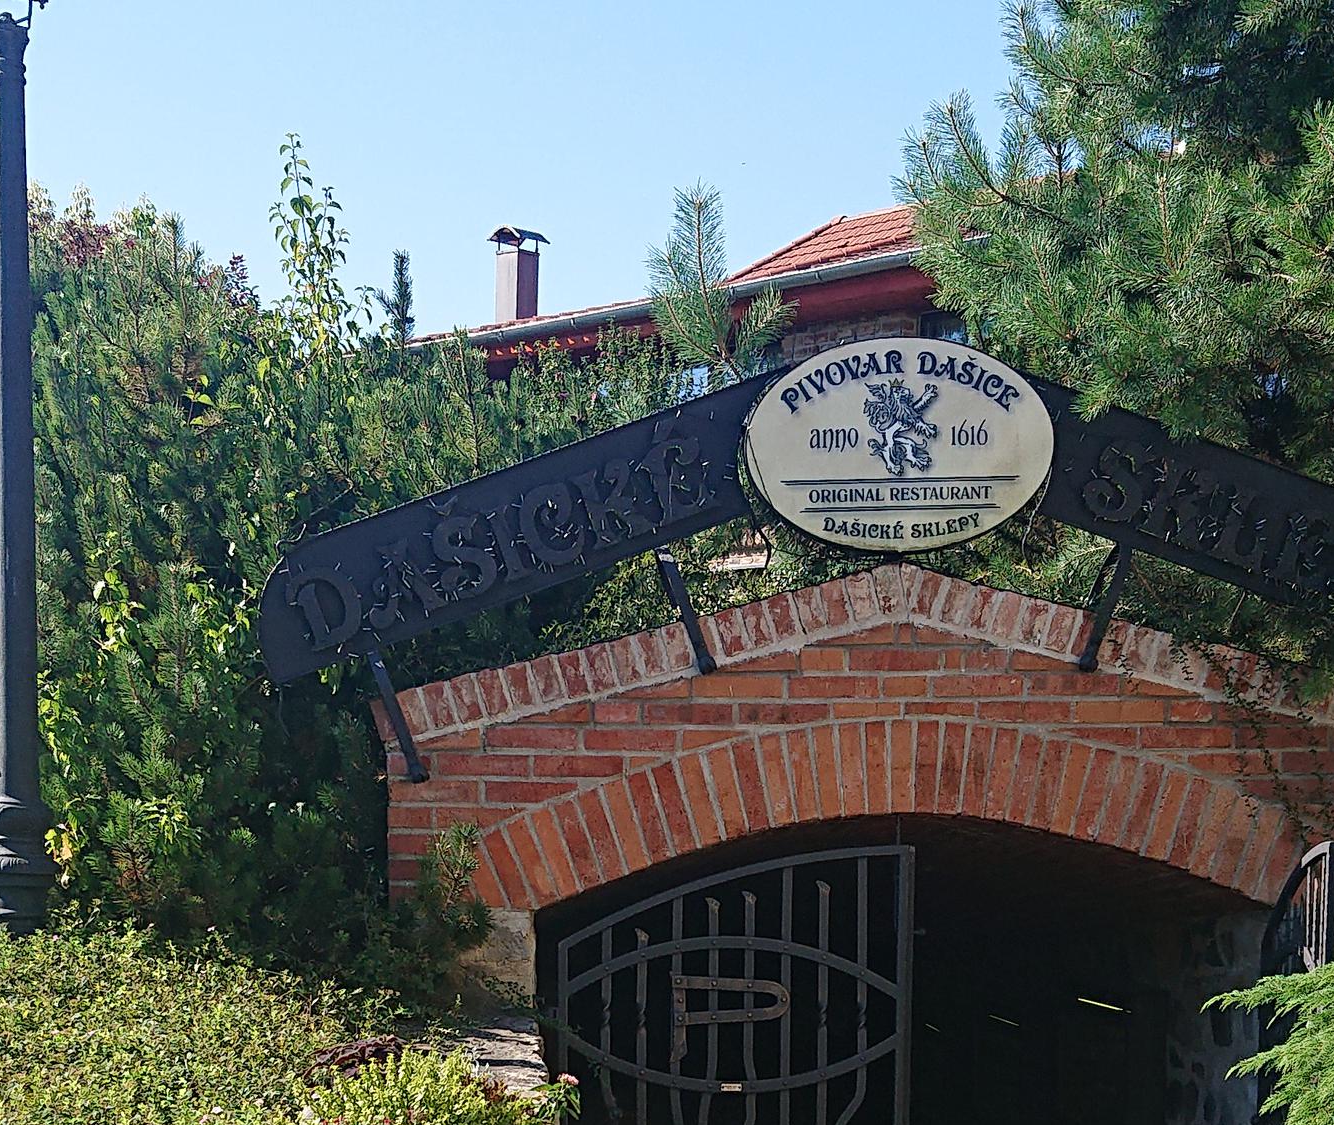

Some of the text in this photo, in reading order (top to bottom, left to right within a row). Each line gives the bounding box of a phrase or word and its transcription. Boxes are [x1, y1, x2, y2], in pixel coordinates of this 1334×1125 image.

[780, 349, 1021, 415] PIVOVAR DAŠICE
[809, 418, 989, 454] anno 1616
[808, 485, 993, 504] ORIGINAL RESTAURANT
[822, 511, 981, 540] DAŠICKÉ SKLEPY
